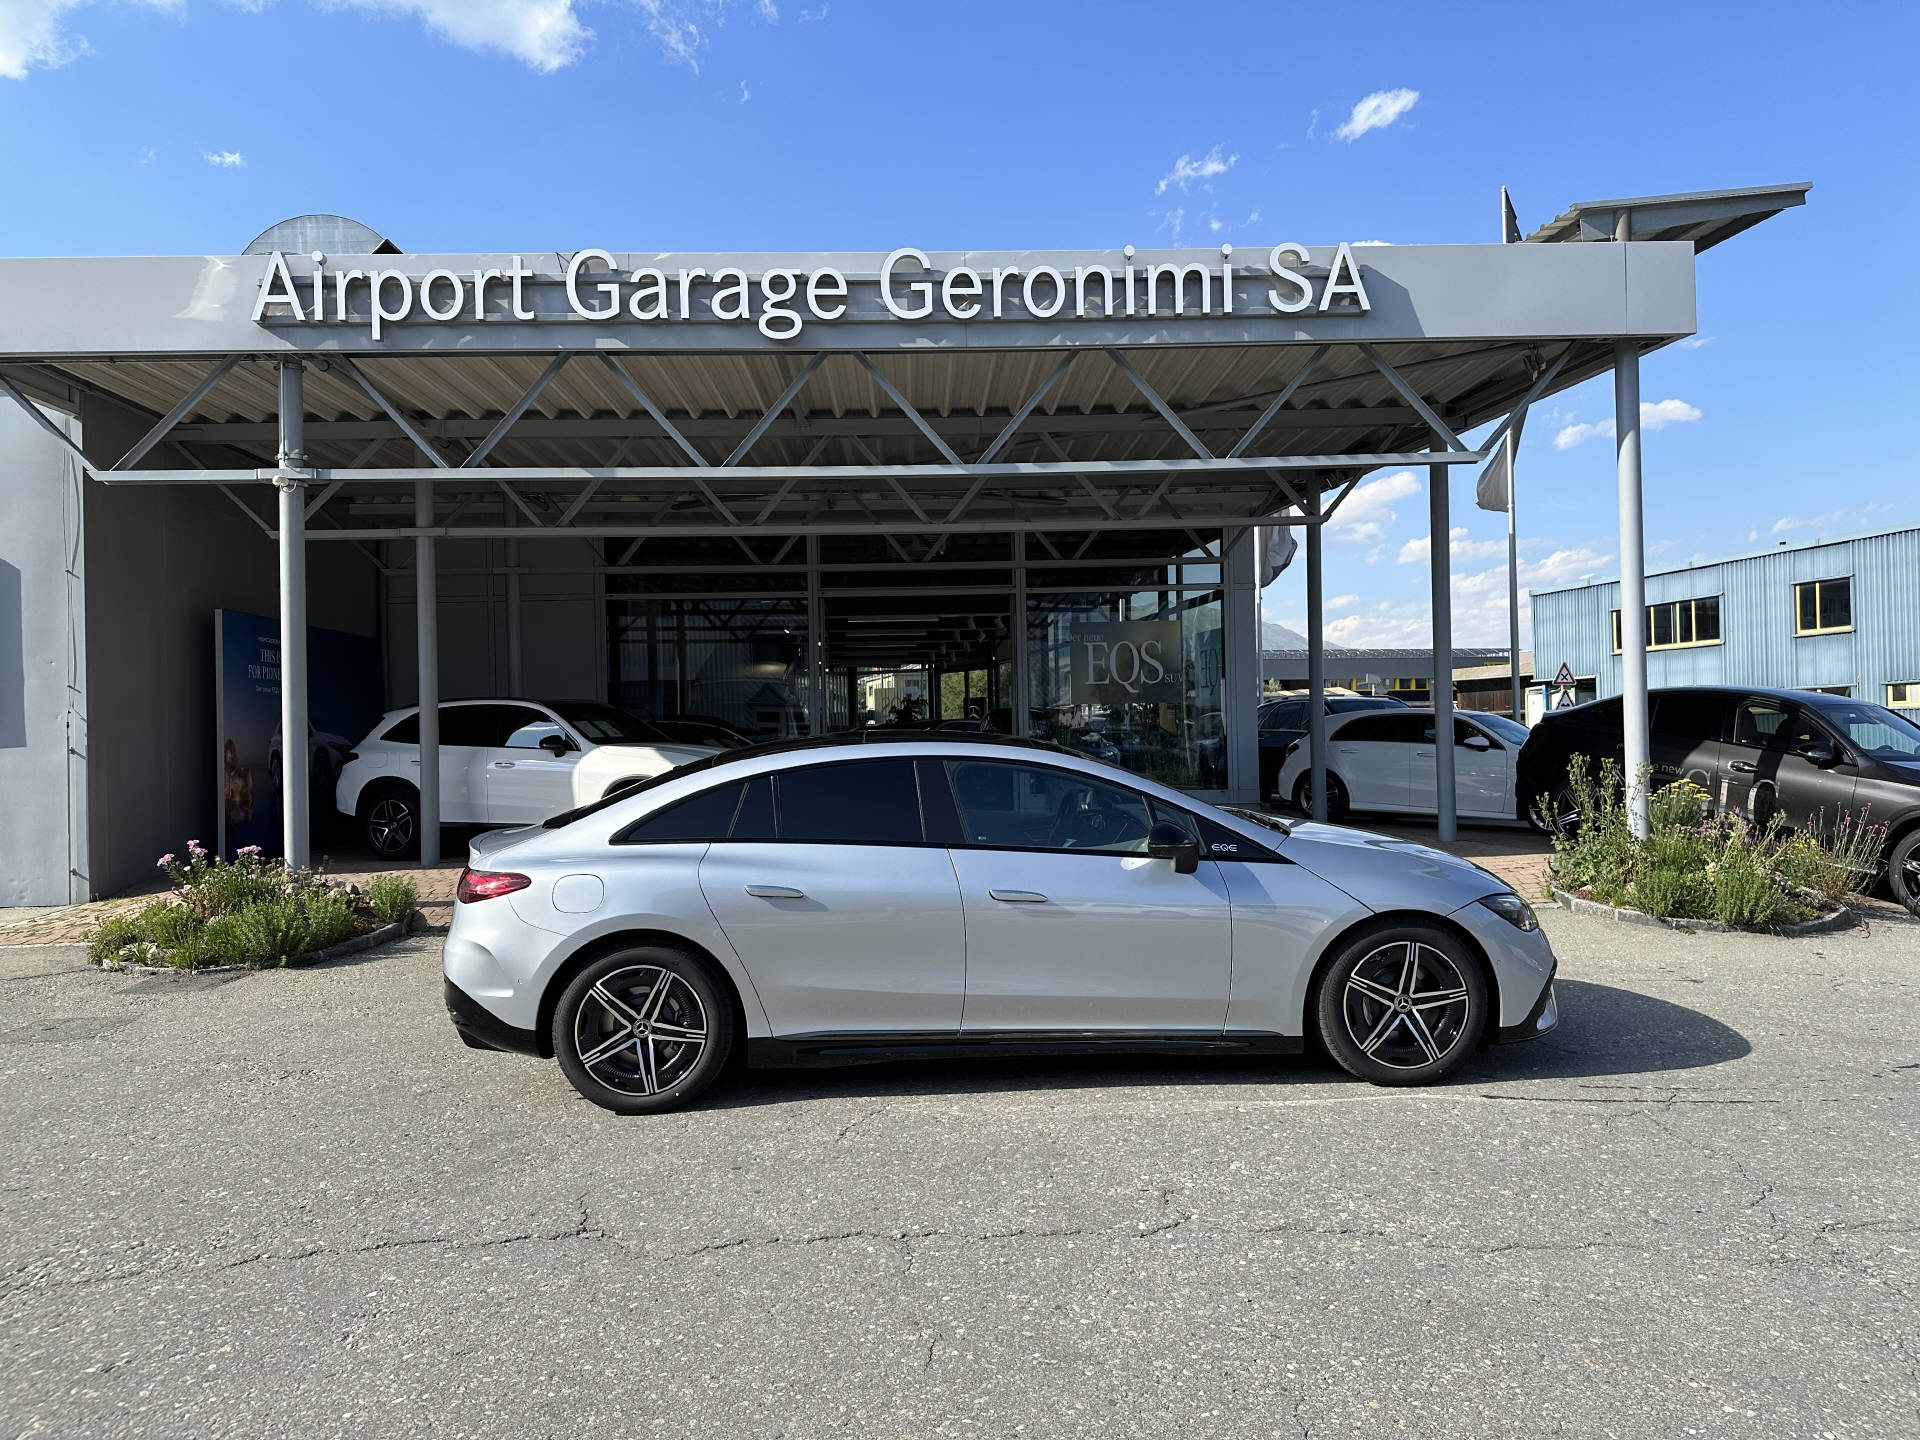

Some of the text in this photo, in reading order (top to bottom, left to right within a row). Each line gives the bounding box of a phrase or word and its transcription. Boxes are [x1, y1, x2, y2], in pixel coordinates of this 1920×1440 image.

[251, 242, 1371, 341] Airport Garage Geronimi SA
[260, 648, 275, 664] THIS
[248, 664, 281, 681] FOR PIONE
[1084, 640, 1164, 694] EQS
[1661, 765, 1684, 775] new
[1211, 843, 1238, 852] EQE
